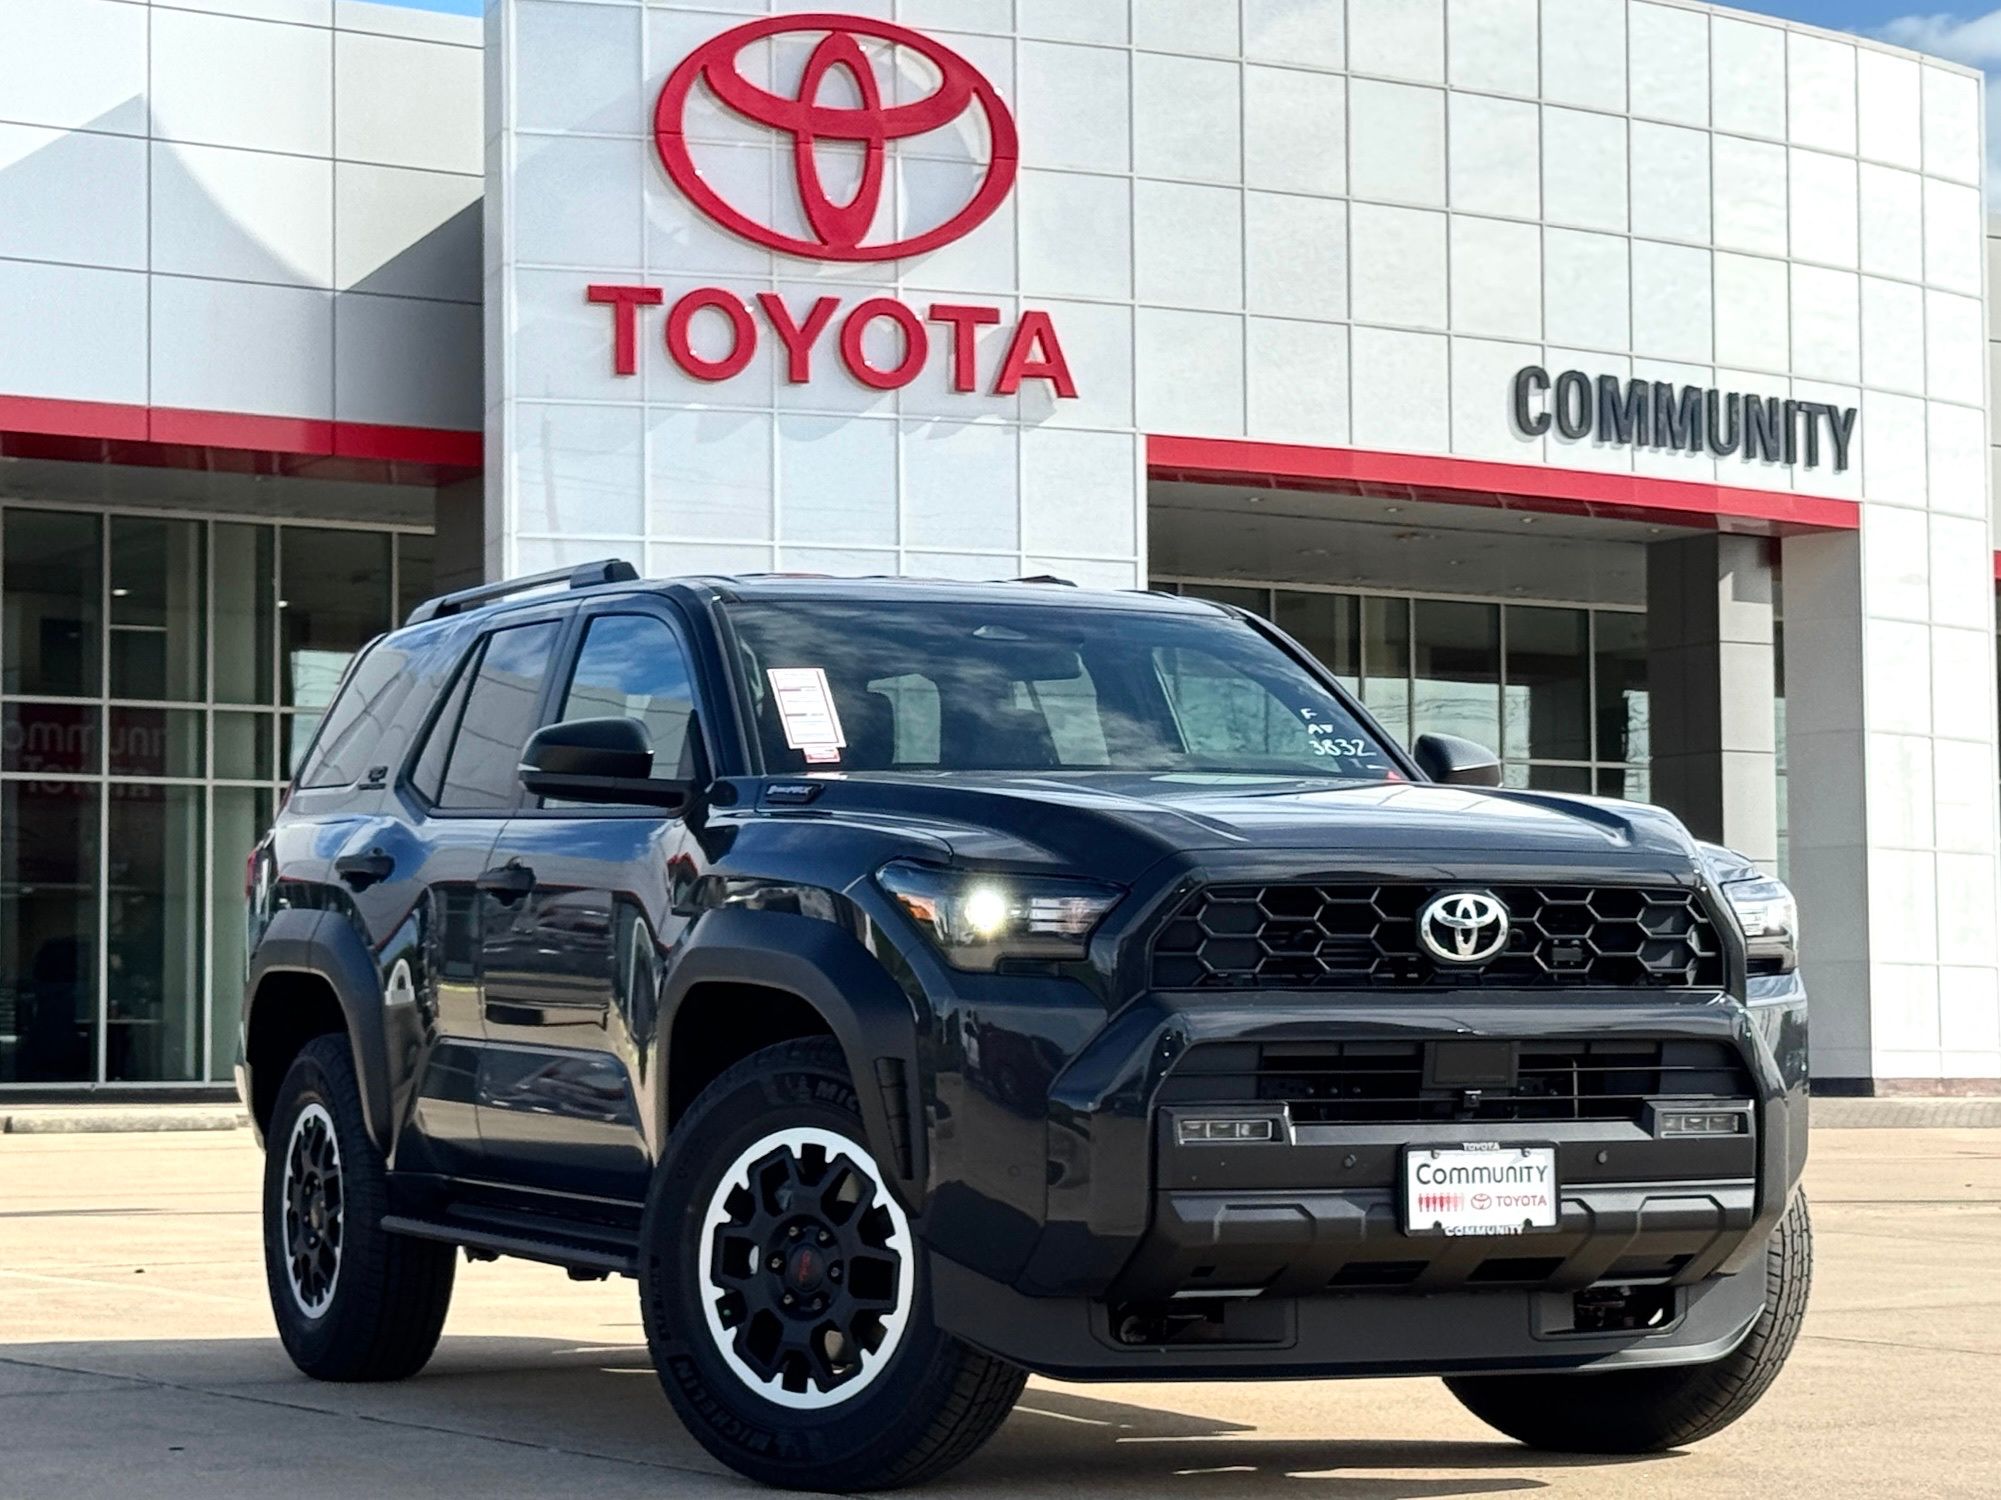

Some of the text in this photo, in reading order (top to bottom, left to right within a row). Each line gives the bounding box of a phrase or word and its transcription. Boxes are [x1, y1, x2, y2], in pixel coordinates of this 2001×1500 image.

[587, 284, 1079, 399] TOYOTA
[1513, 365, 1858, 471] COMMUNITY
[1308, 739, 1378, 757] 3832
[1463, 1142, 1500, 1151] TOYOTA
[1496, 1194, 1548, 1208] TOYOTA
[1444, 1224, 1524, 1237] COMMUNITY
